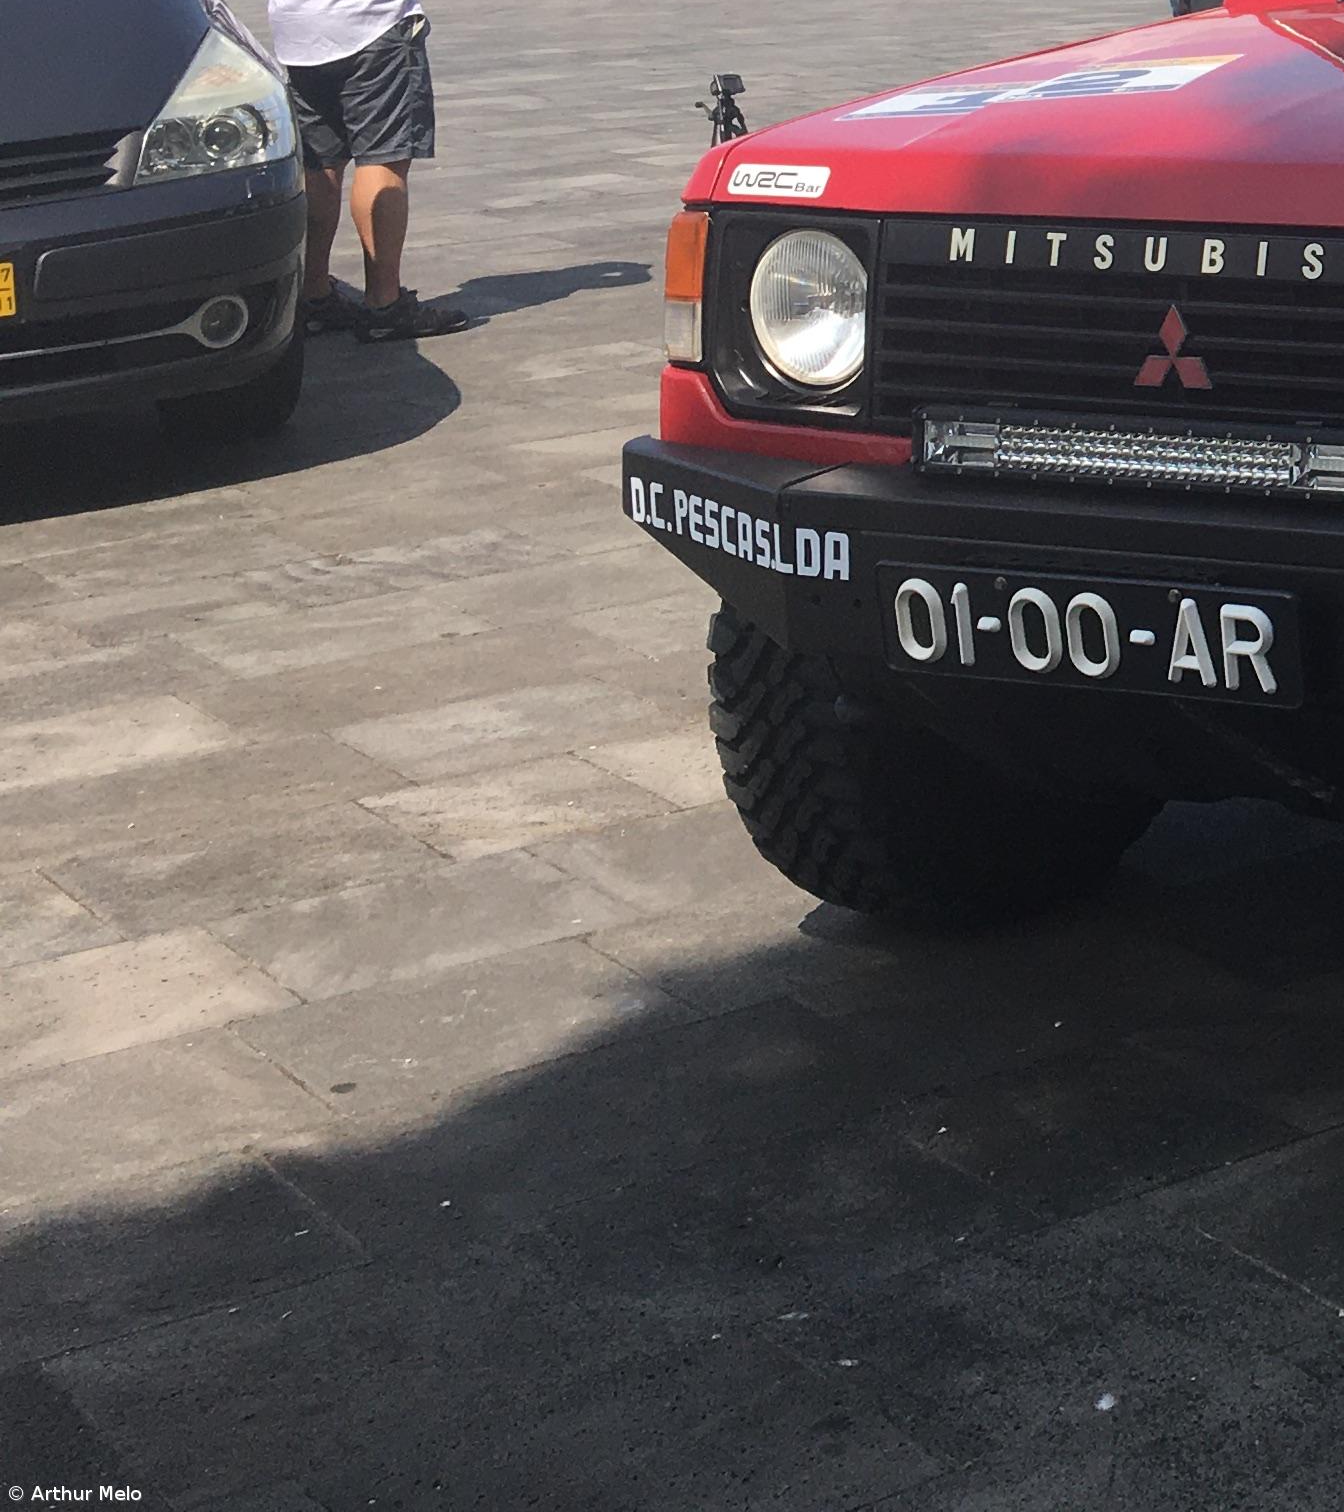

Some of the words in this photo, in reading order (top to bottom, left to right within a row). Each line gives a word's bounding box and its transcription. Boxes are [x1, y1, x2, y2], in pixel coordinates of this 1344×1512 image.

[733, 170, 798, 190] WRC
[794, 182, 822, 193] Bar
[895, 578, 1278, 695] 01-00-AR
